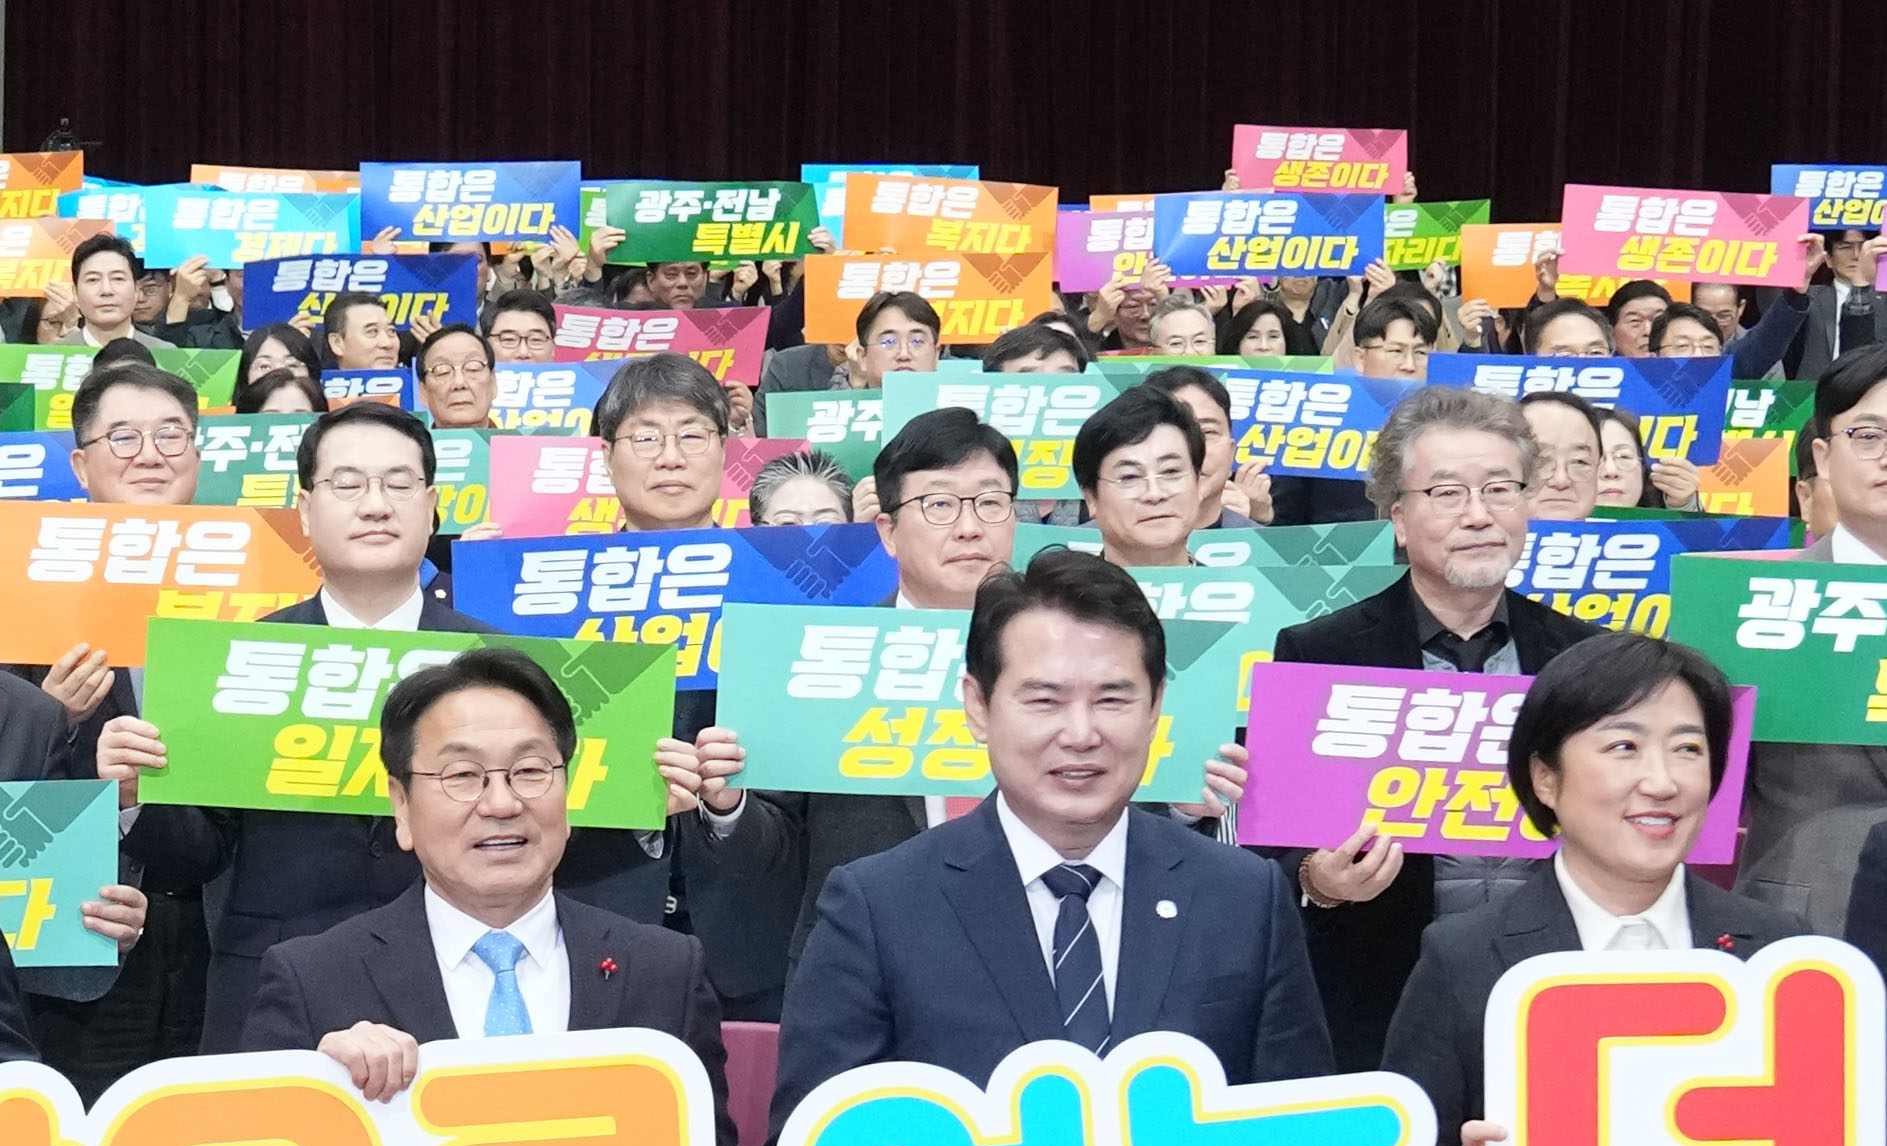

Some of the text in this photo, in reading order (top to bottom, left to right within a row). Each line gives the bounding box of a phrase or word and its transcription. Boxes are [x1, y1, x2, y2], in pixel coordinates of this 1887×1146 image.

[1255, 132, 1346, 161] 통합은
[388, 169, 498, 204] 통합은
[1272, 161, 1389, 189] 생존이다
[1794, 170, 1885, 198] 통합은
[76, 194, 145, 221] 통합
[172, 197, 280, 231] 통합은
[634, 189, 782, 222] 광주·전남
[871, 181, 979, 219] 통합은
[1182, 199, 1298, 236] 통합은
[1594, 194, 1719, 237] 통합은
[412, 202, 555, 237] 산업이다
[926, 218, 1033, 254] 복지다
[1086, 216, 1154, 251] 통합
[230, 231, 338, 262] 경제다
[692, 222, 800, 256] 특별시
[1206, 235, 1359, 271] 산업이다
[1616, 235, 1779, 278] 생존이다
[272, 259, 389, 293] 통합은
[837, 261, 961, 299] 통합은
[555, 314, 679, 352] 통합은
[21, 354, 93, 391] 통합
[493, 371, 577, 408] 합은
[1235, 423, 1375, 472] 산업이
[27, 516, 252, 587] 통합은
[512, 542, 733, 616] 통합은
[787, 624, 967, 702] 통합
